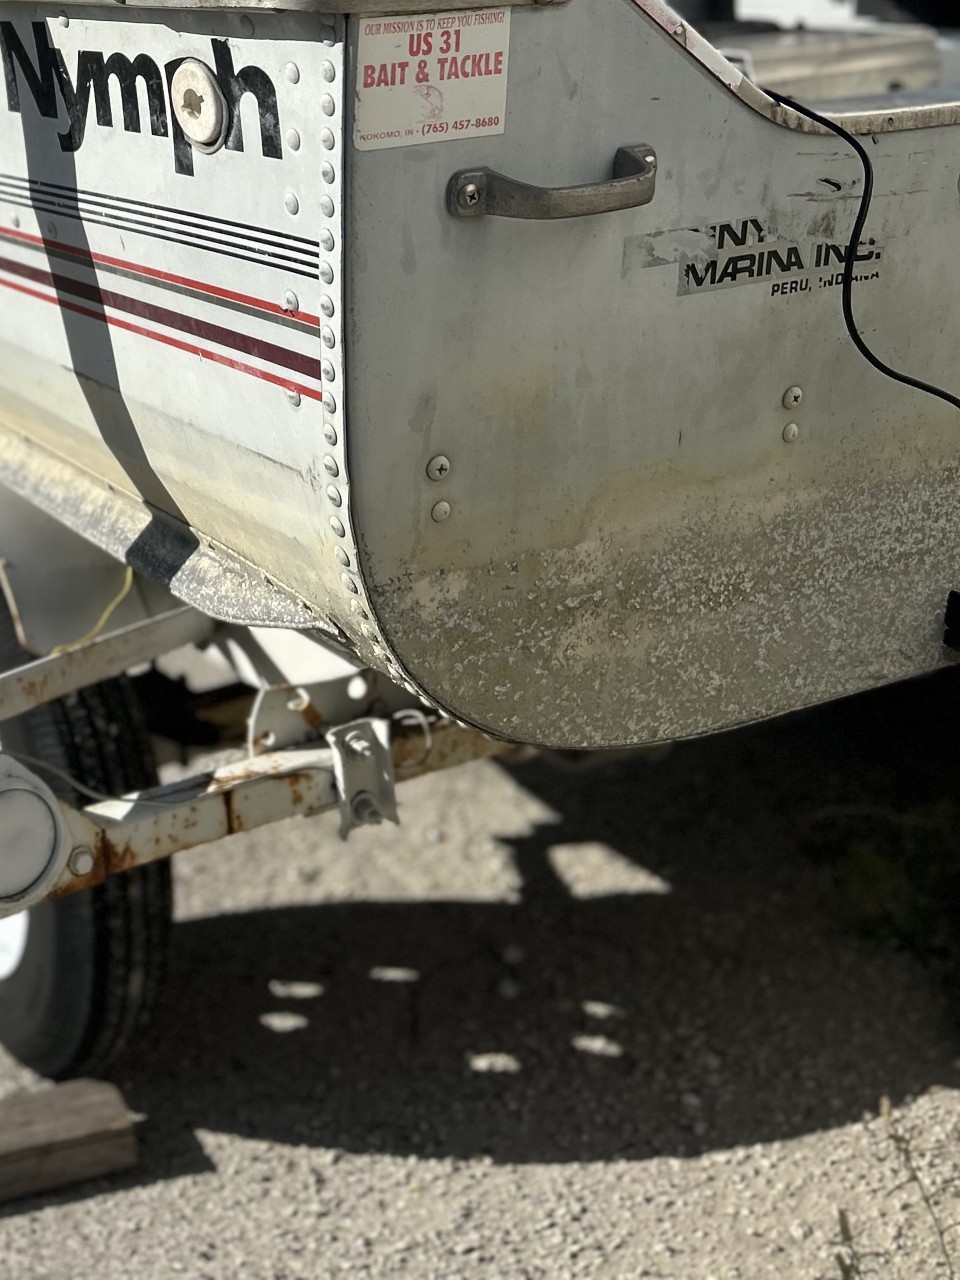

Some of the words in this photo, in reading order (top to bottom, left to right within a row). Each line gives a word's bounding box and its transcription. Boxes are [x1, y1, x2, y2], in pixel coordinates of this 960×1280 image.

[365, 23, 381, 36] OUR
[382, 20, 414, 34] MISSION
[416, 20, 425, 31] IS
[426, 19, 436, 31] TO
[437, 17, 455, 30] KEEP
[457, 16, 473, 27] YOU
[474, 11, 505, 25] FISHING!
[409, 32, 432, 57] US
[440, 29, 461, 55] 31
[363, 61, 409, 88] BAIT
[415, 59, 430, 83] &
[437, 51, 504, 81] TACKLE
[405, 128, 414, 136] IN
[421, 122, 449, 135] (765)
[452, 116, 500, 130] 457-8680
[684, 247, 804, 287] MARINA
[771, 278, 812, 296] PERU,
